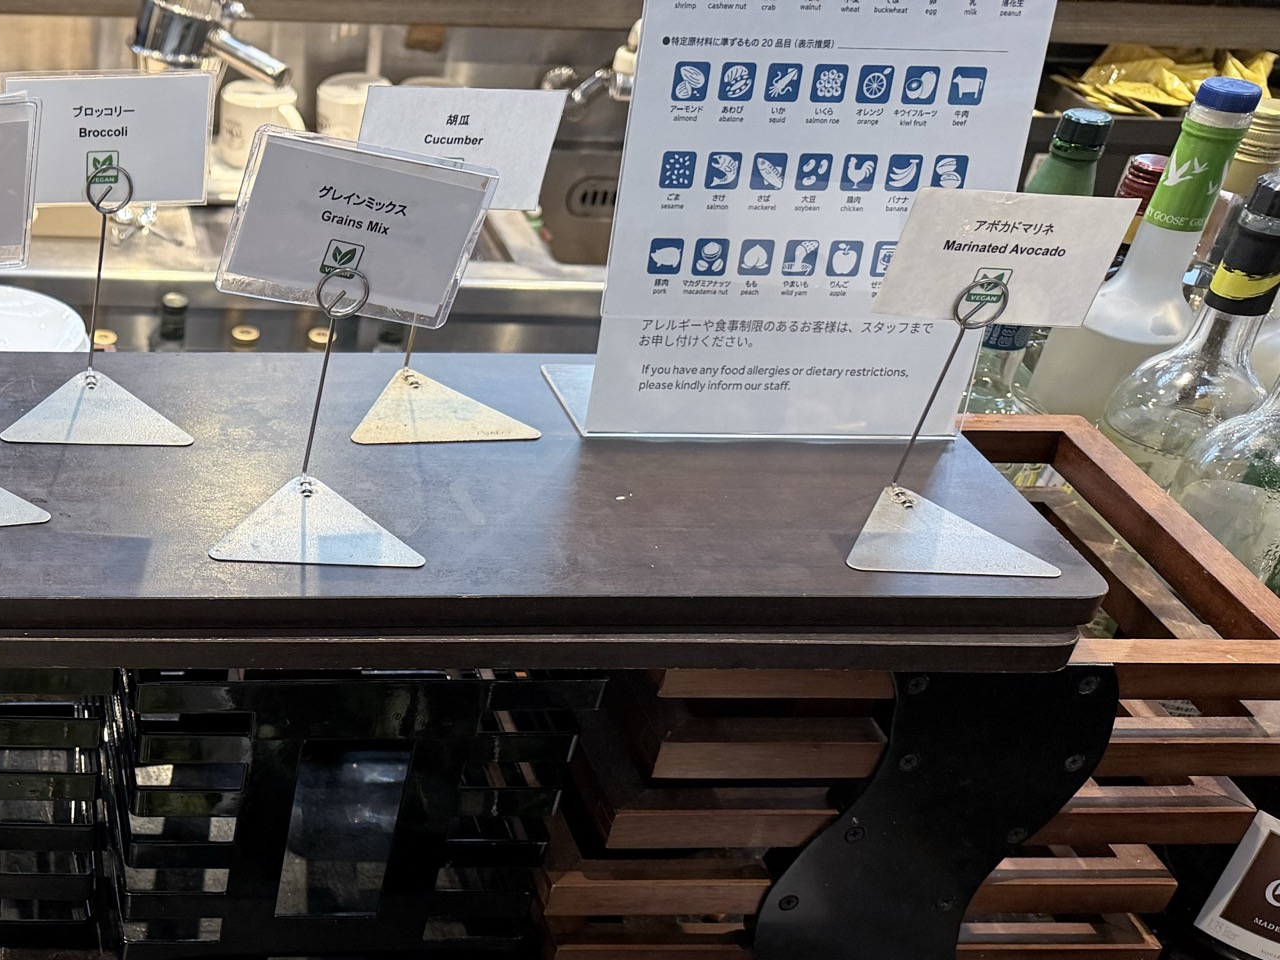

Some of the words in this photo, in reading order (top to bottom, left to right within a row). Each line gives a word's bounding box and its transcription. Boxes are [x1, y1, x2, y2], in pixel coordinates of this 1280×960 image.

[873, 6, 908, 14] buckwheat
[924, 8, 938, 16] egg
[72, 105, 135, 119] ブロッコリー
[670, 105, 703, 114] アーモンド
[721, 105, 744, 114] あわび
[771, 106, 786, 115] いか
[814, 107, 834, 115] いくら
[856, 107, 884, 117] オレンジ
[893, 108, 938, 117] キウイフルーツ
[954, 110, 969, 118] 牛肉
[445, 114, 470, 128] 胡瓜
[673, 114, 697, 122] almond
[769, 116, 786, 124] squid
[913, 119, 927, 127] fruit
[952, 119, 967, 127] beef
[78, 126, 128, 139] Broccoli
[424, 133, 484, 147] Cucumber
[318, 184, 408, 218] グレインミックス
[667, 193, 680, 201] ごま
[712, 194, 725, 202] さけ
[801, 195, 816, 204] 大豆
[888, 195, 909, 204] バナナ
[748, 203, 777, 211] mackerel
[321, 210, 363, 231] Grains
[366, 219, 390, 237] Mix
[974, 219, 1055, 236] アボカドマリネ
[943, 240, 1008, 254] Marinated
[1009, 244, 1066, 258] Avocado
[654, 279, 669, 287] 豚肉
[682, 280, 731, 288] マカダミアナッツ
[745, 280, 758, 288] もも
[829, 281, 850, 289] りんご
[971, 294, 997, 302] VEGAN
[641, 319, 934, 334] アレルギーや食事制限のあるお客様は、スタッフまで
[638, 334, 754, 348] お申し付けください。
[641, 364, 652, 376] If
[650, 366, 671, 378] you
[672, 365, 698, 376] have
[699, 367, 719, 378] any
[720, 364, 745, 376] food
[746, 365, 791, 378] allergies
[792, 367, 803, 376] or
[805, 365, 843, 378] dietary
[845, 366, 909, 378] restrictions,
[638, 380, 673, 392] please
[675, 379, 705, 392] kindly
[707, 380, 742, 391] inform
[744, 382, 761, 391] our
[763, 380, 791, 391] staff.
